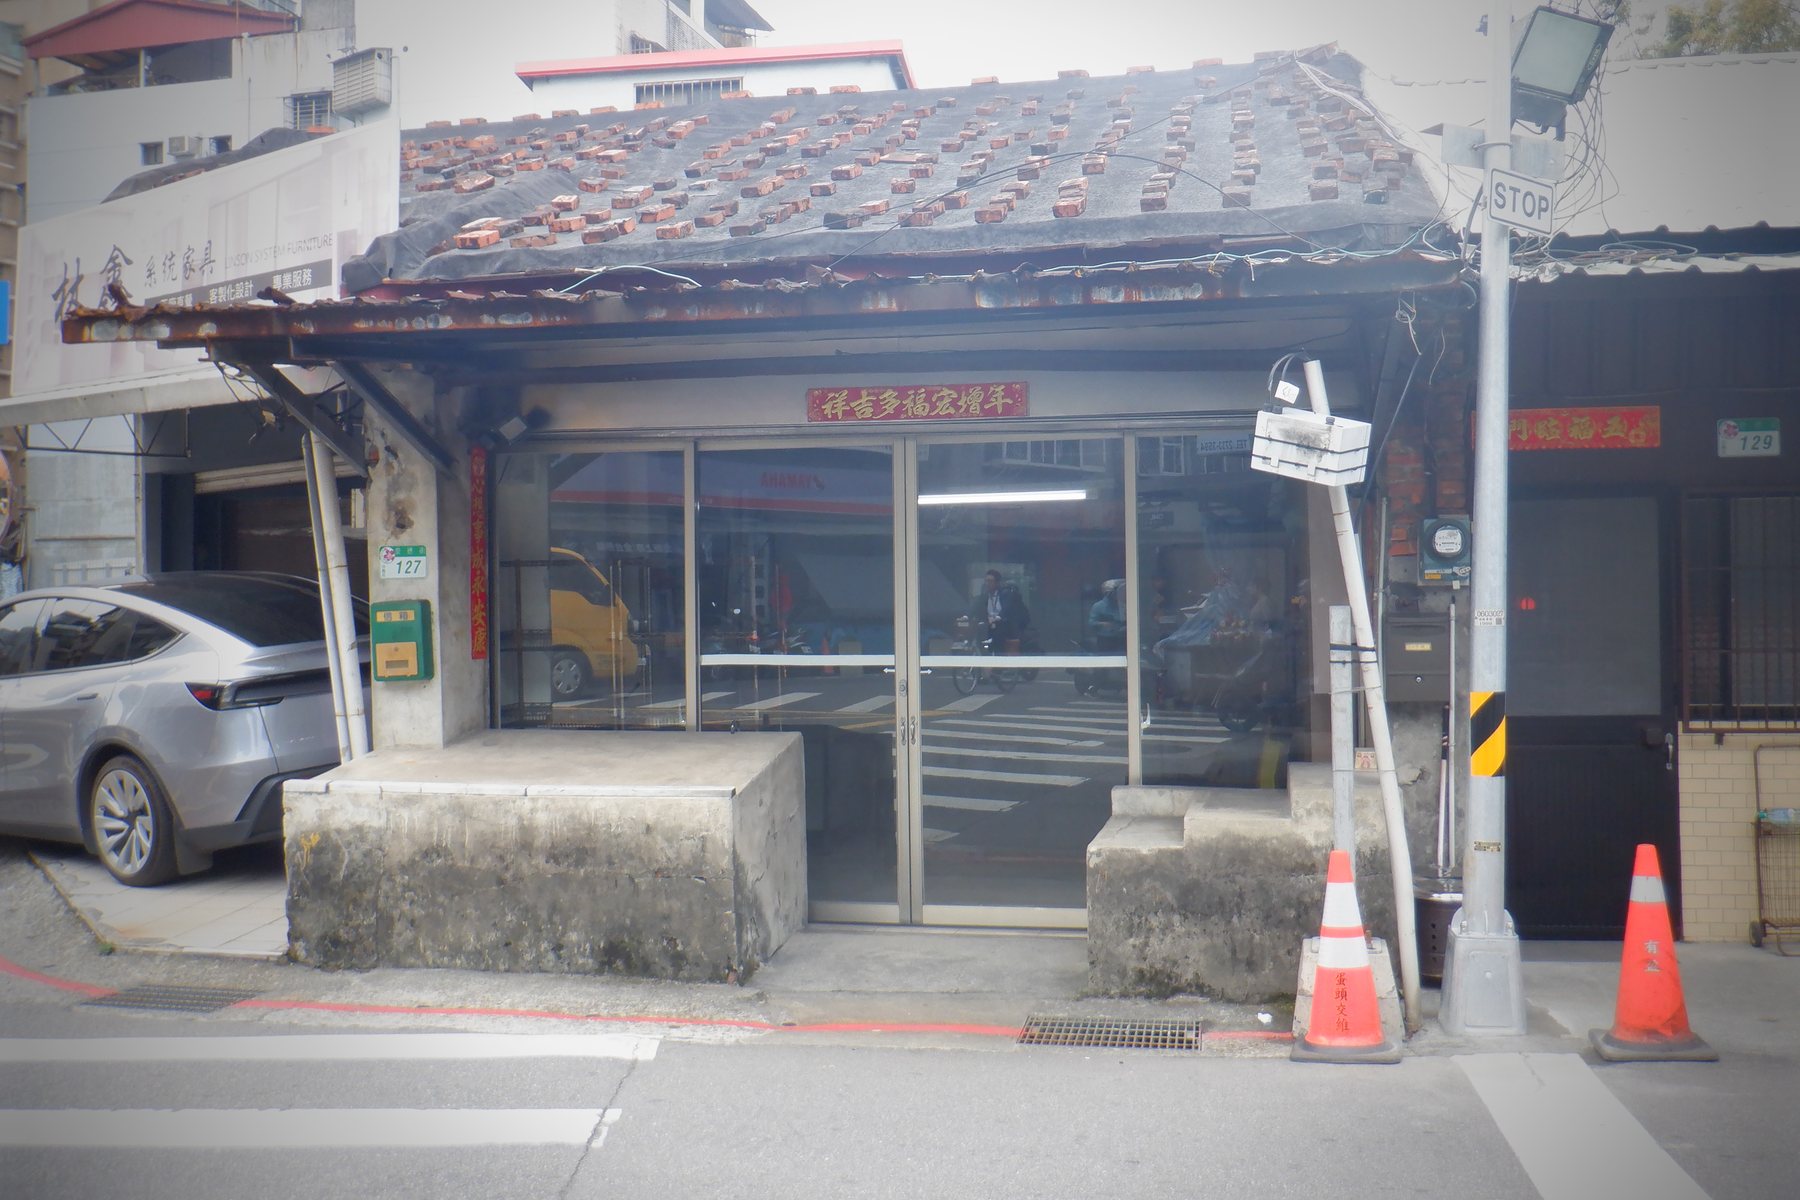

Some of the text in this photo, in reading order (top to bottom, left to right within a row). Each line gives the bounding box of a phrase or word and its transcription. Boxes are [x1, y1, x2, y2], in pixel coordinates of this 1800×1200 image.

[1493, 181, 1550, 220] STOP
[144, 240, 216, 287] 系統家具
[254, 244, 286, 263] SYSTEM
[287, 233, 333, 256] FURNITURE
[208, 281, 254, 305] 客製化設計
[272, 268, 313, 291] 專業服務
[1741, 434, 1773, 451] 129
[396, 559, 422, 575] 127
